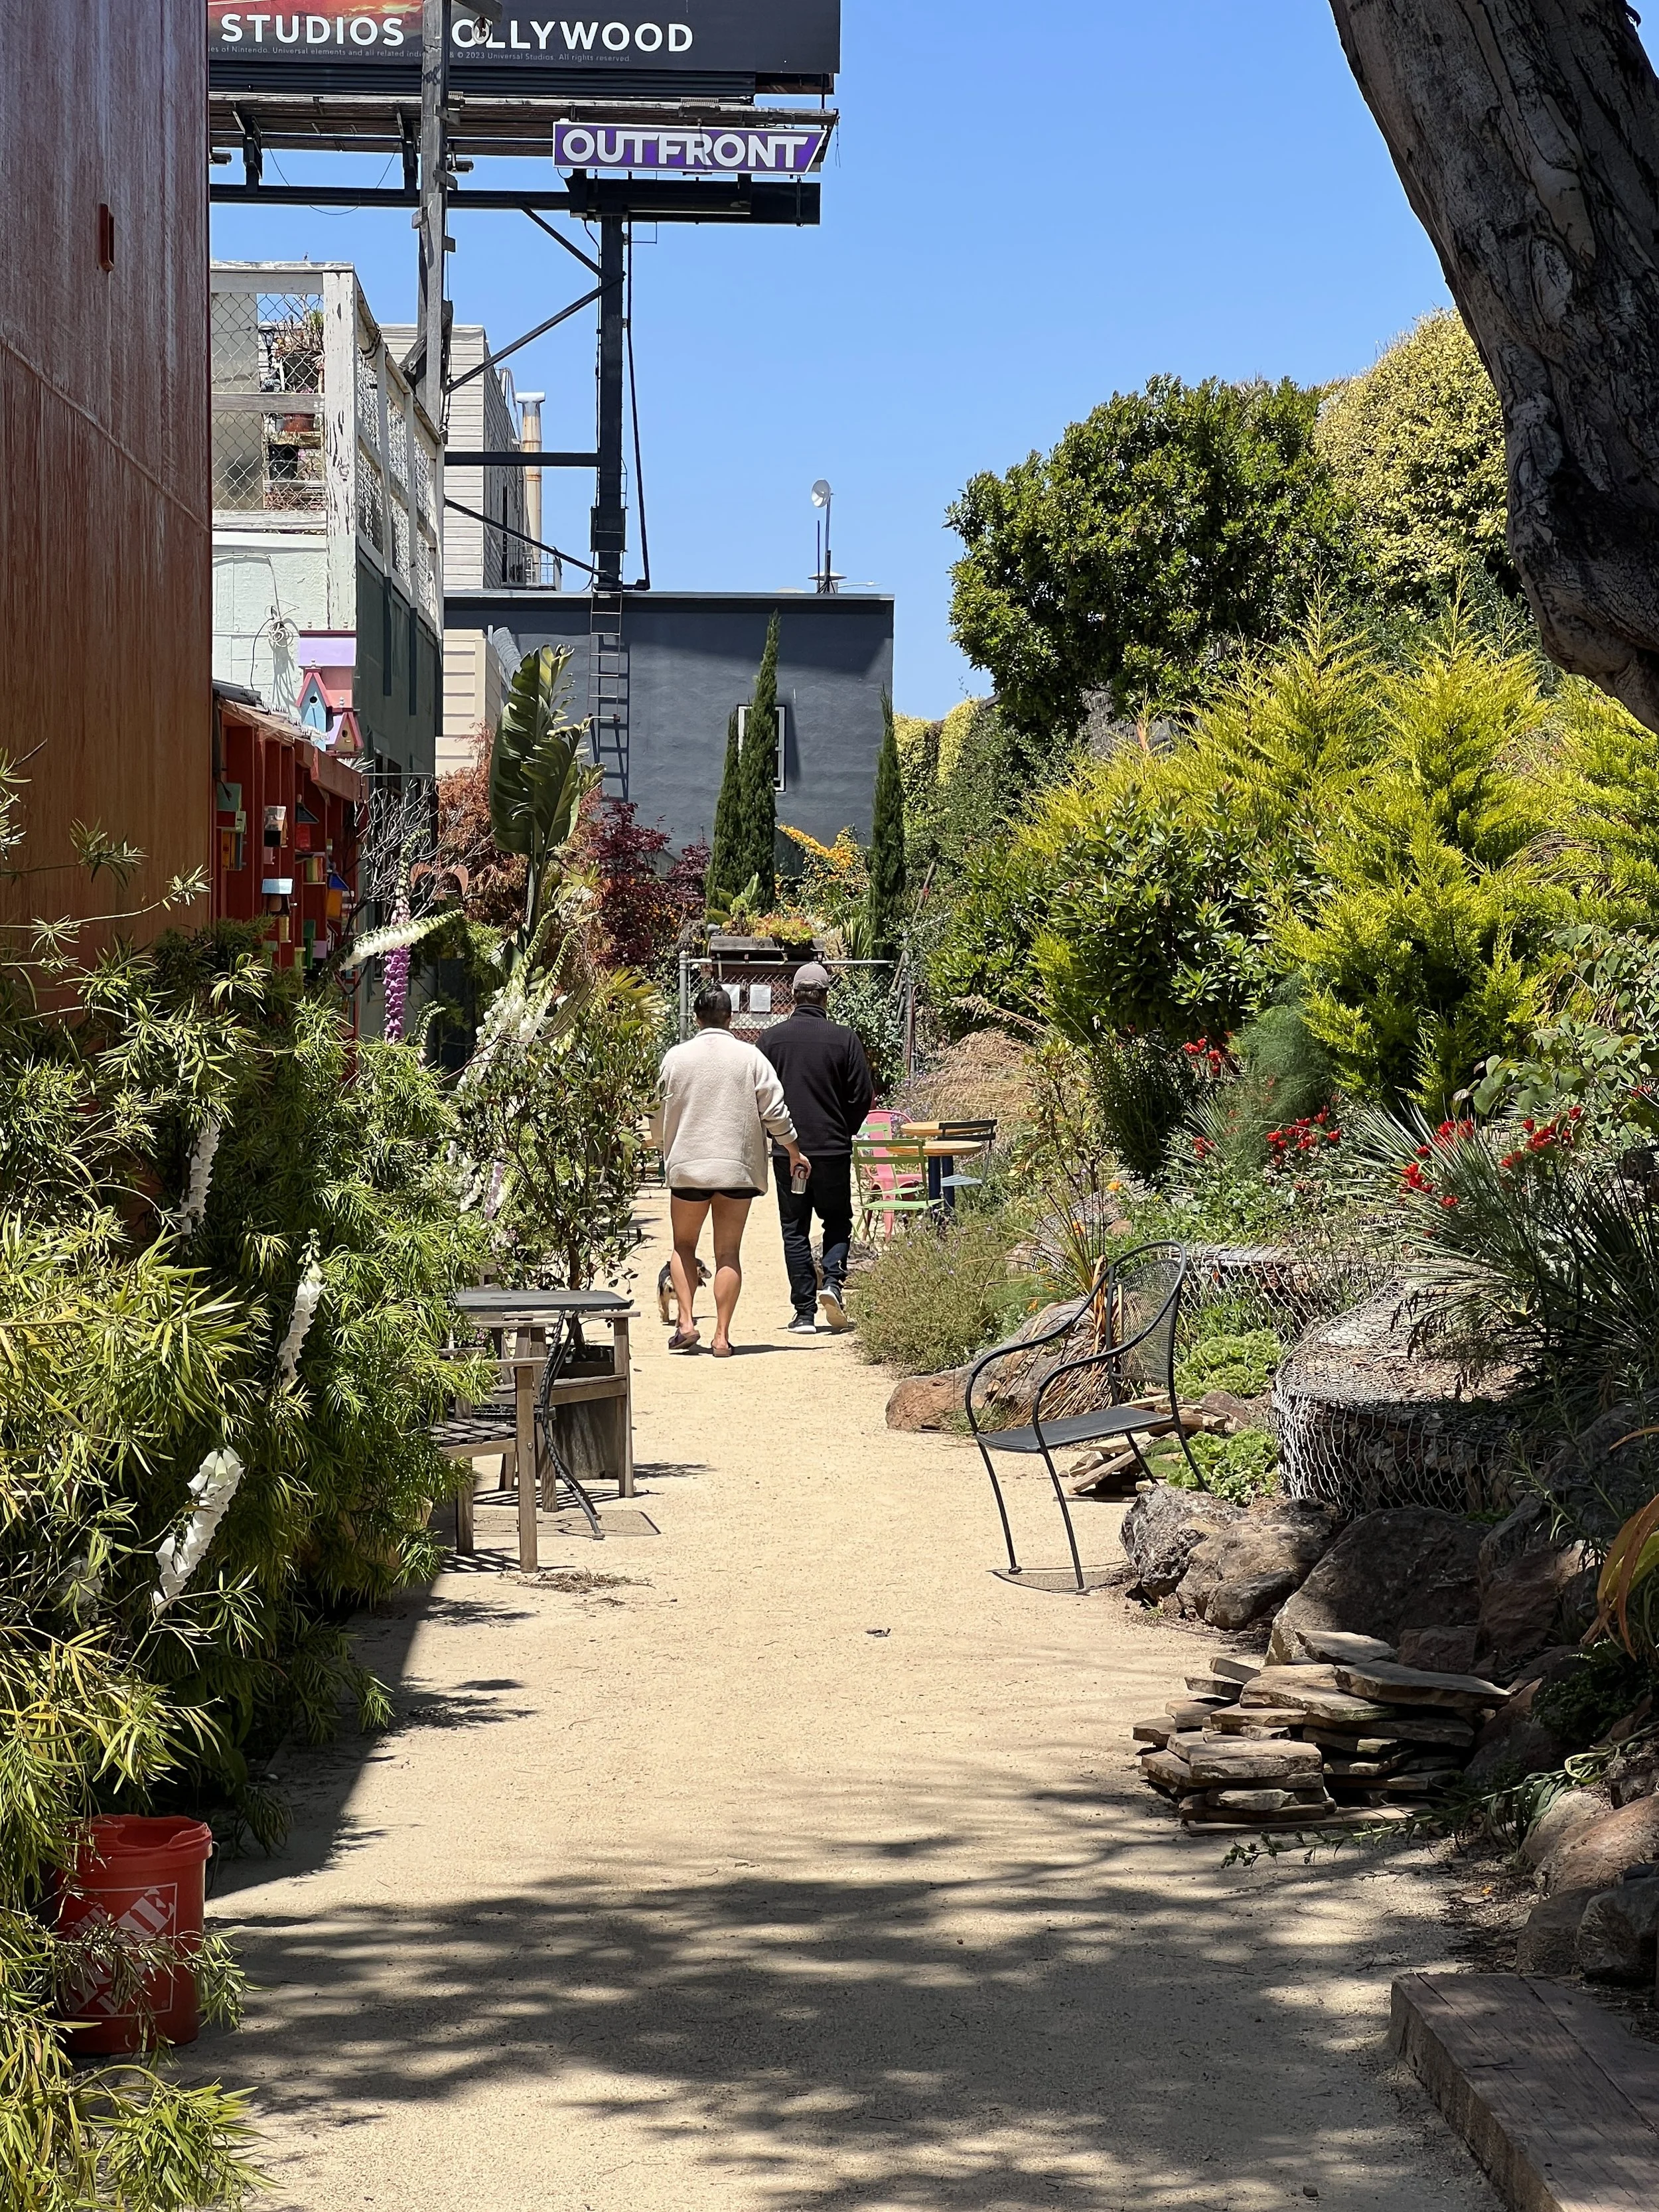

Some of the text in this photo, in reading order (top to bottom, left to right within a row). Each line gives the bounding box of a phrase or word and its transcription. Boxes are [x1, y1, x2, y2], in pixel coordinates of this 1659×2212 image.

[220, 13, 693, 52] STUDIOS OLLYWOOD
[311, 47, 346, 56] elements
[571, 54, 594, 62] rights
[562, 128, 809, 169] OUTFRONT
